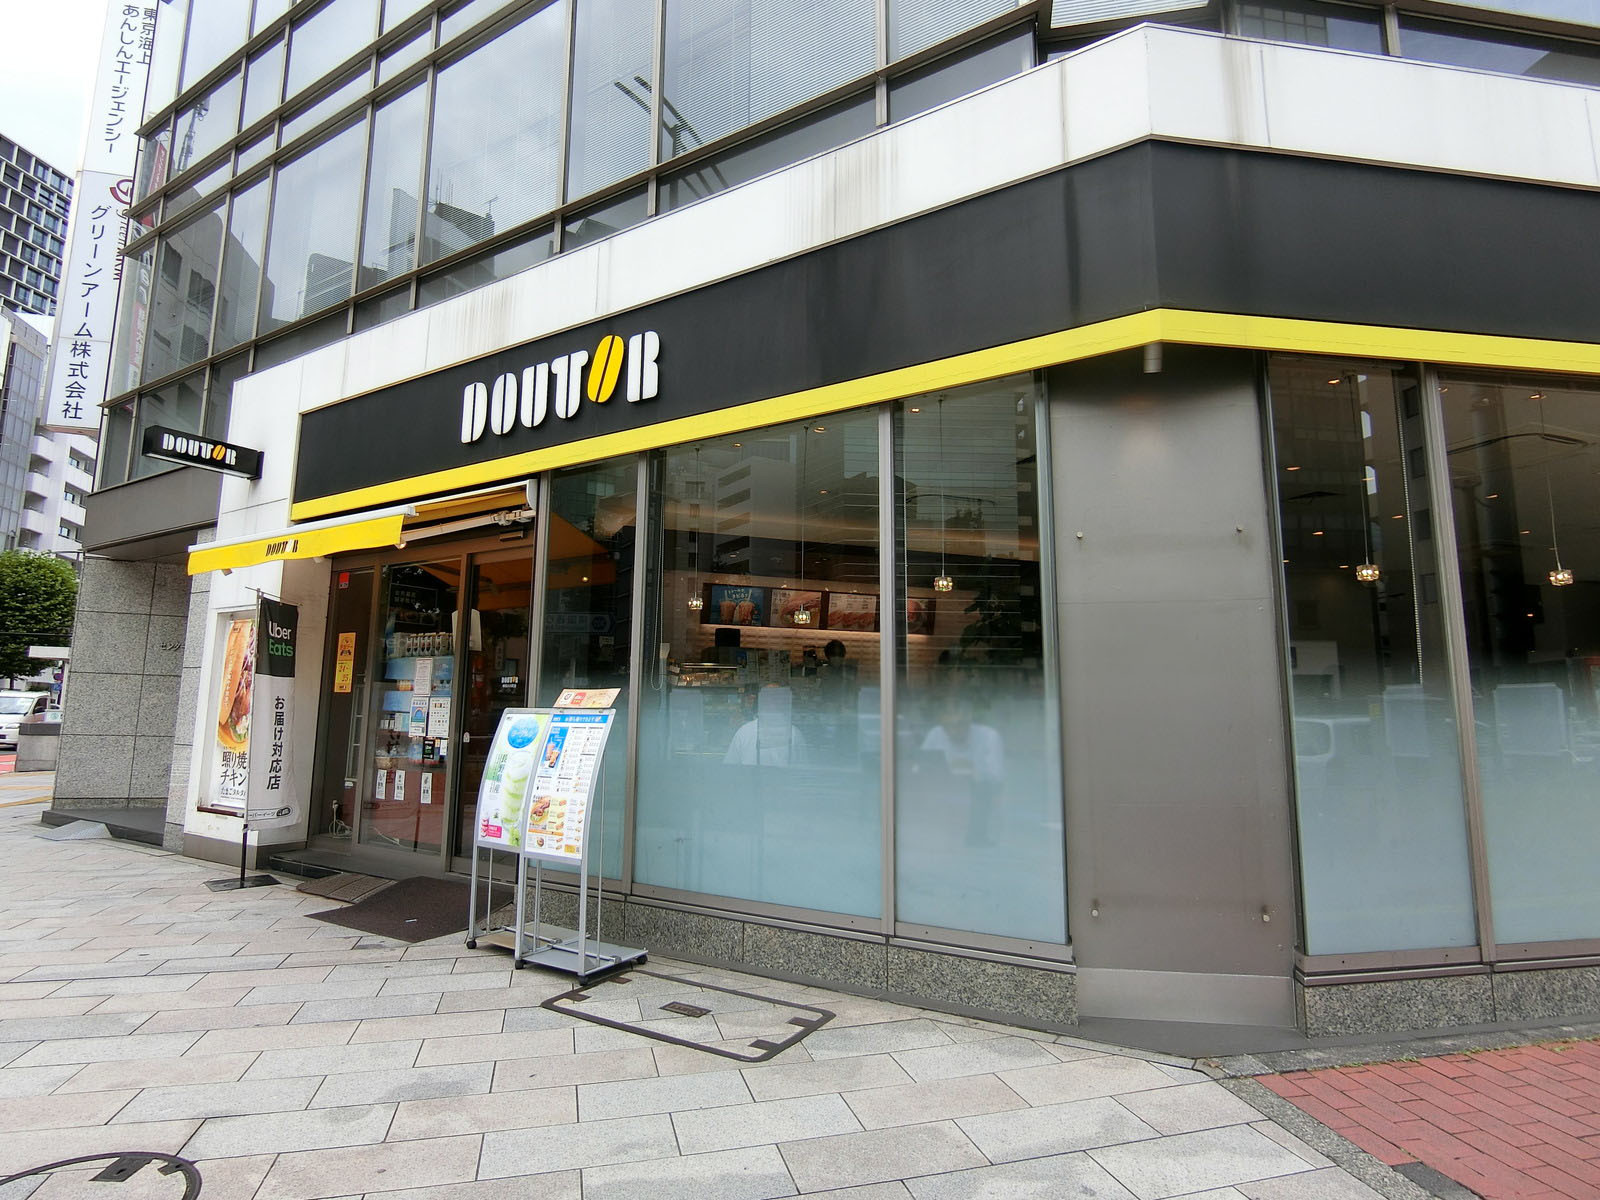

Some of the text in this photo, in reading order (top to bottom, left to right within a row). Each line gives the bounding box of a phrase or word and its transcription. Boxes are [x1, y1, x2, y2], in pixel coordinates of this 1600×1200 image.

[104, 4, 140, 153] あんしんエージェンシー
[62, 205, 112, 420] グリーンアーム株式会社
[460, 329, 660, 445] DOUTOR
[162, 433, 237, 466] DOUTOR
[265, 539, 299, 557] DOUTOR
[268, 620, 292, 640] Uber
[268, 638, 294, 657] Eats
[266, 695, 286, 790] お届け対応店
[220, 768, 247, 788] チキン
